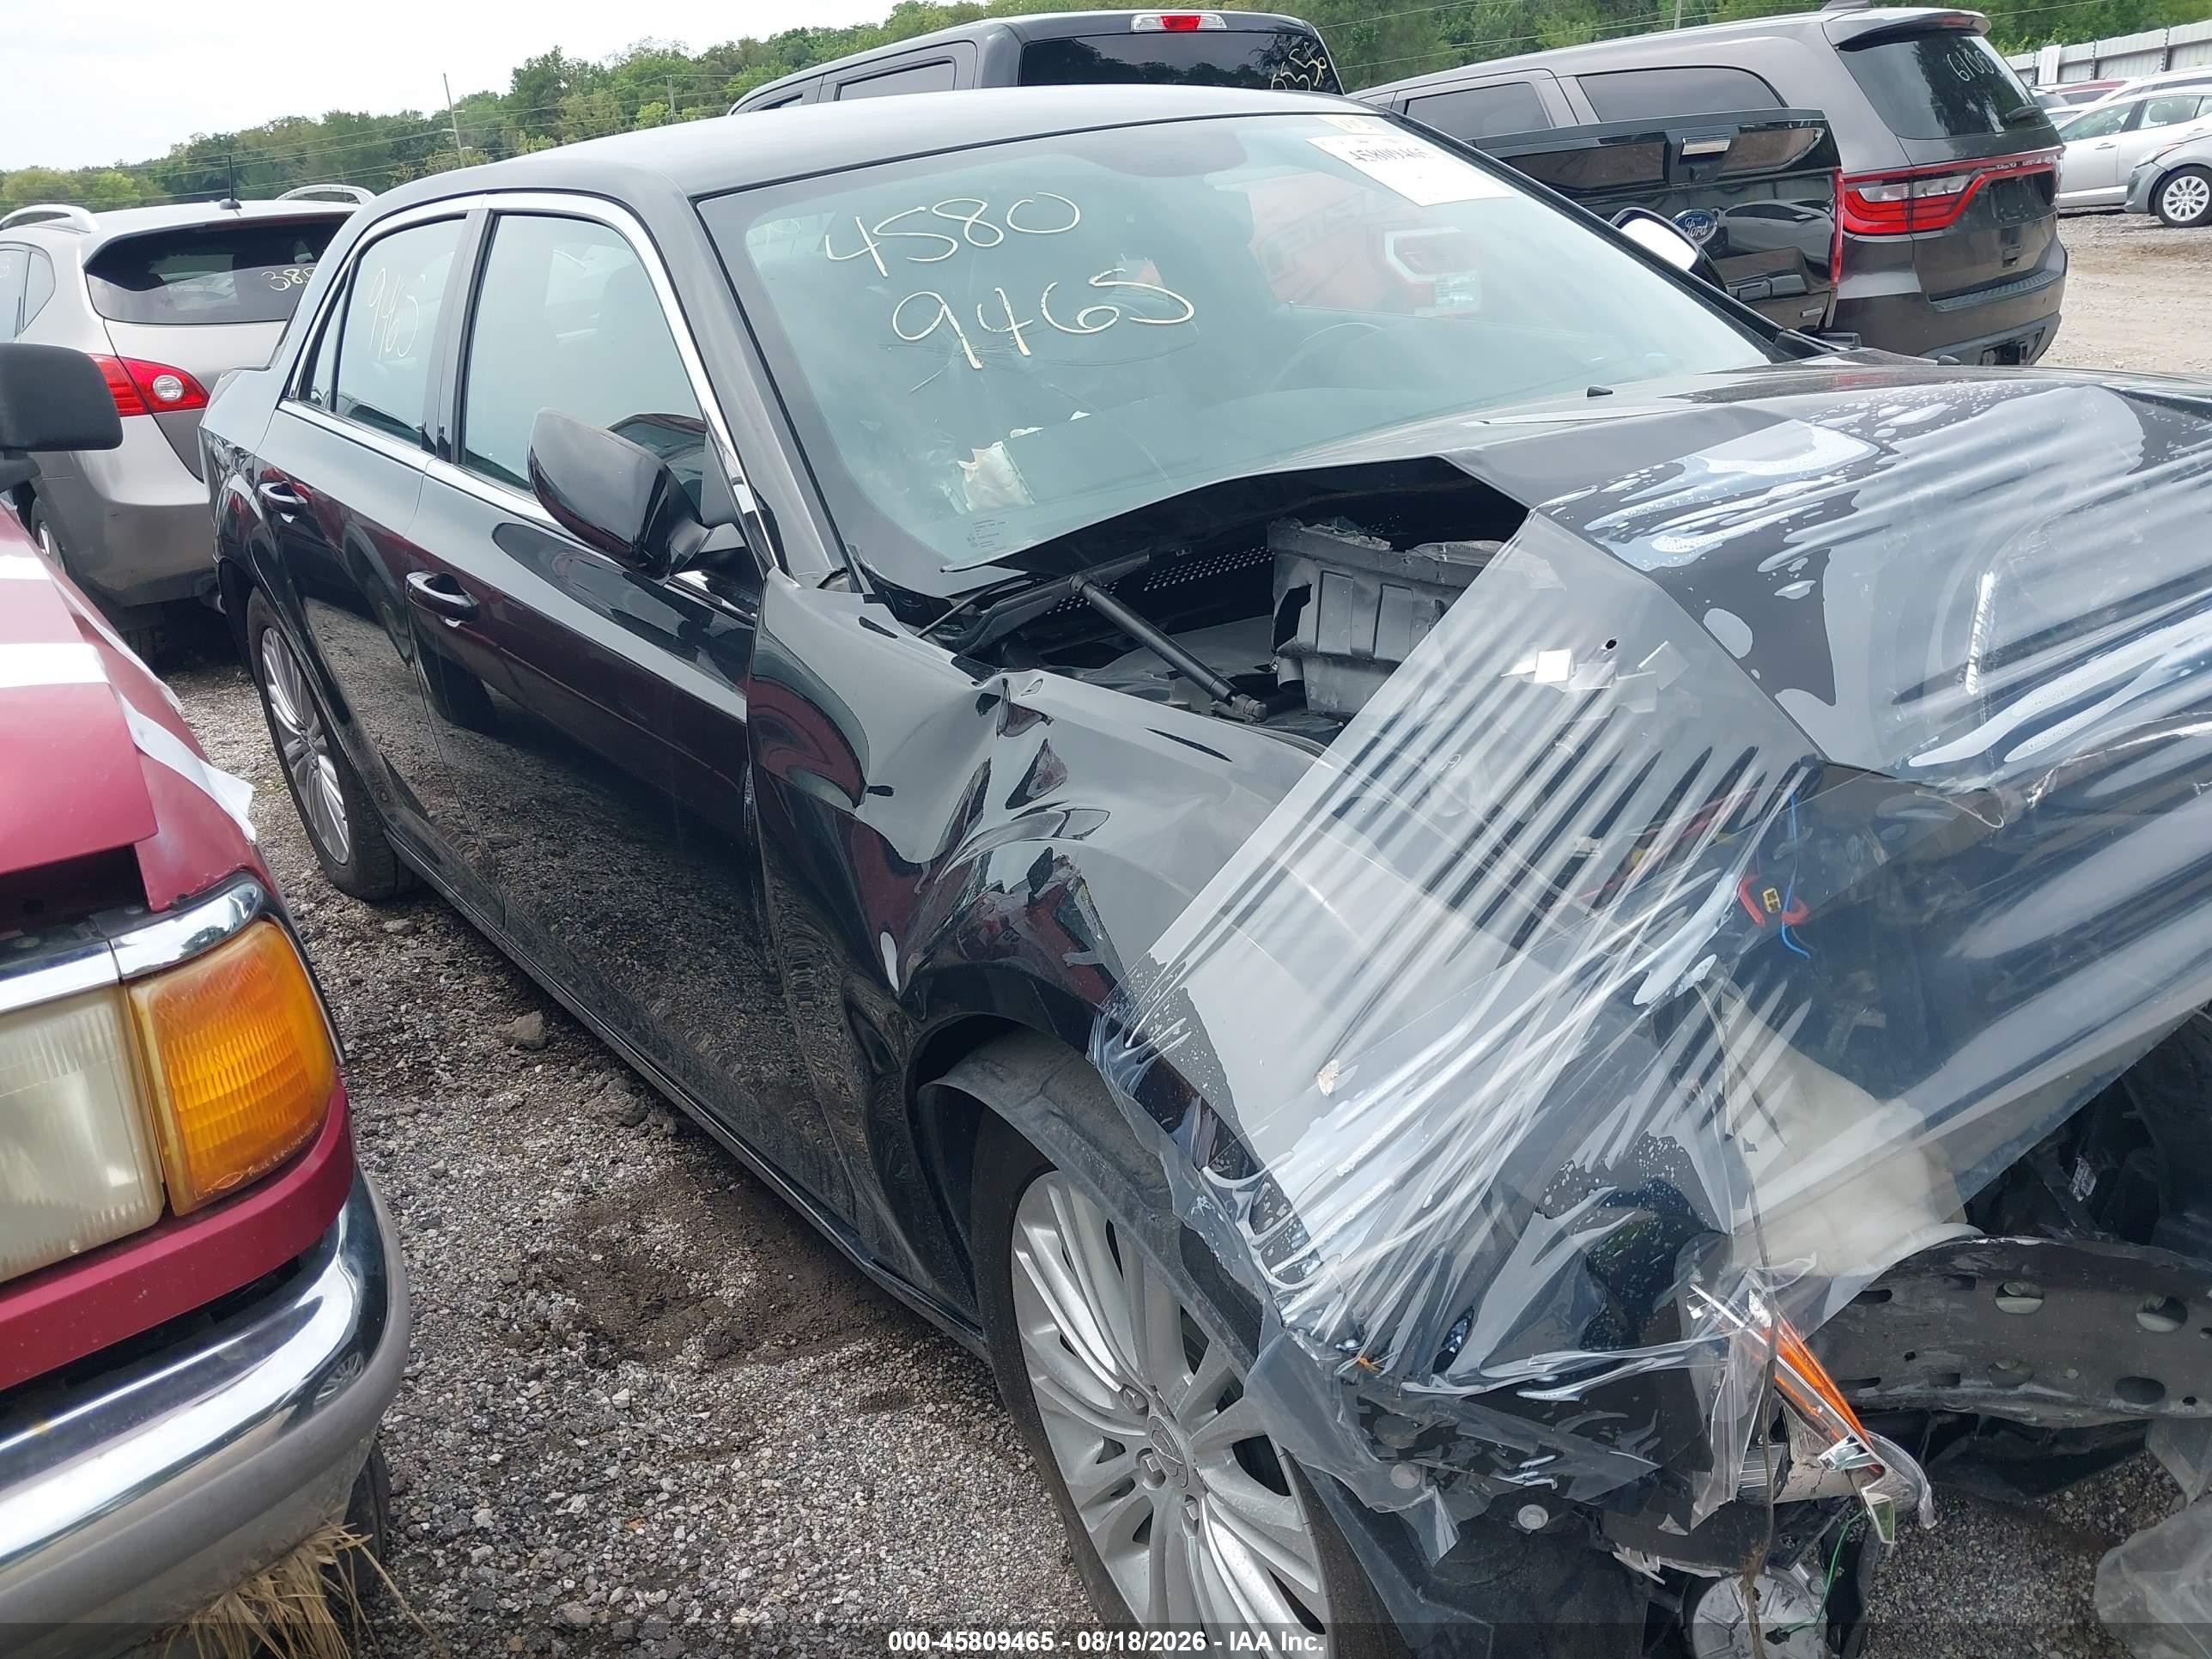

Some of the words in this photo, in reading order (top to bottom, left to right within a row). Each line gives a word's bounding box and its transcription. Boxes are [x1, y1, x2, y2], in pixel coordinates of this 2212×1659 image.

[825, 191, 1081, 276] 4580
[1684, 216, 1709, 238] Ford
[892, 268, 1195, 369] 9465
